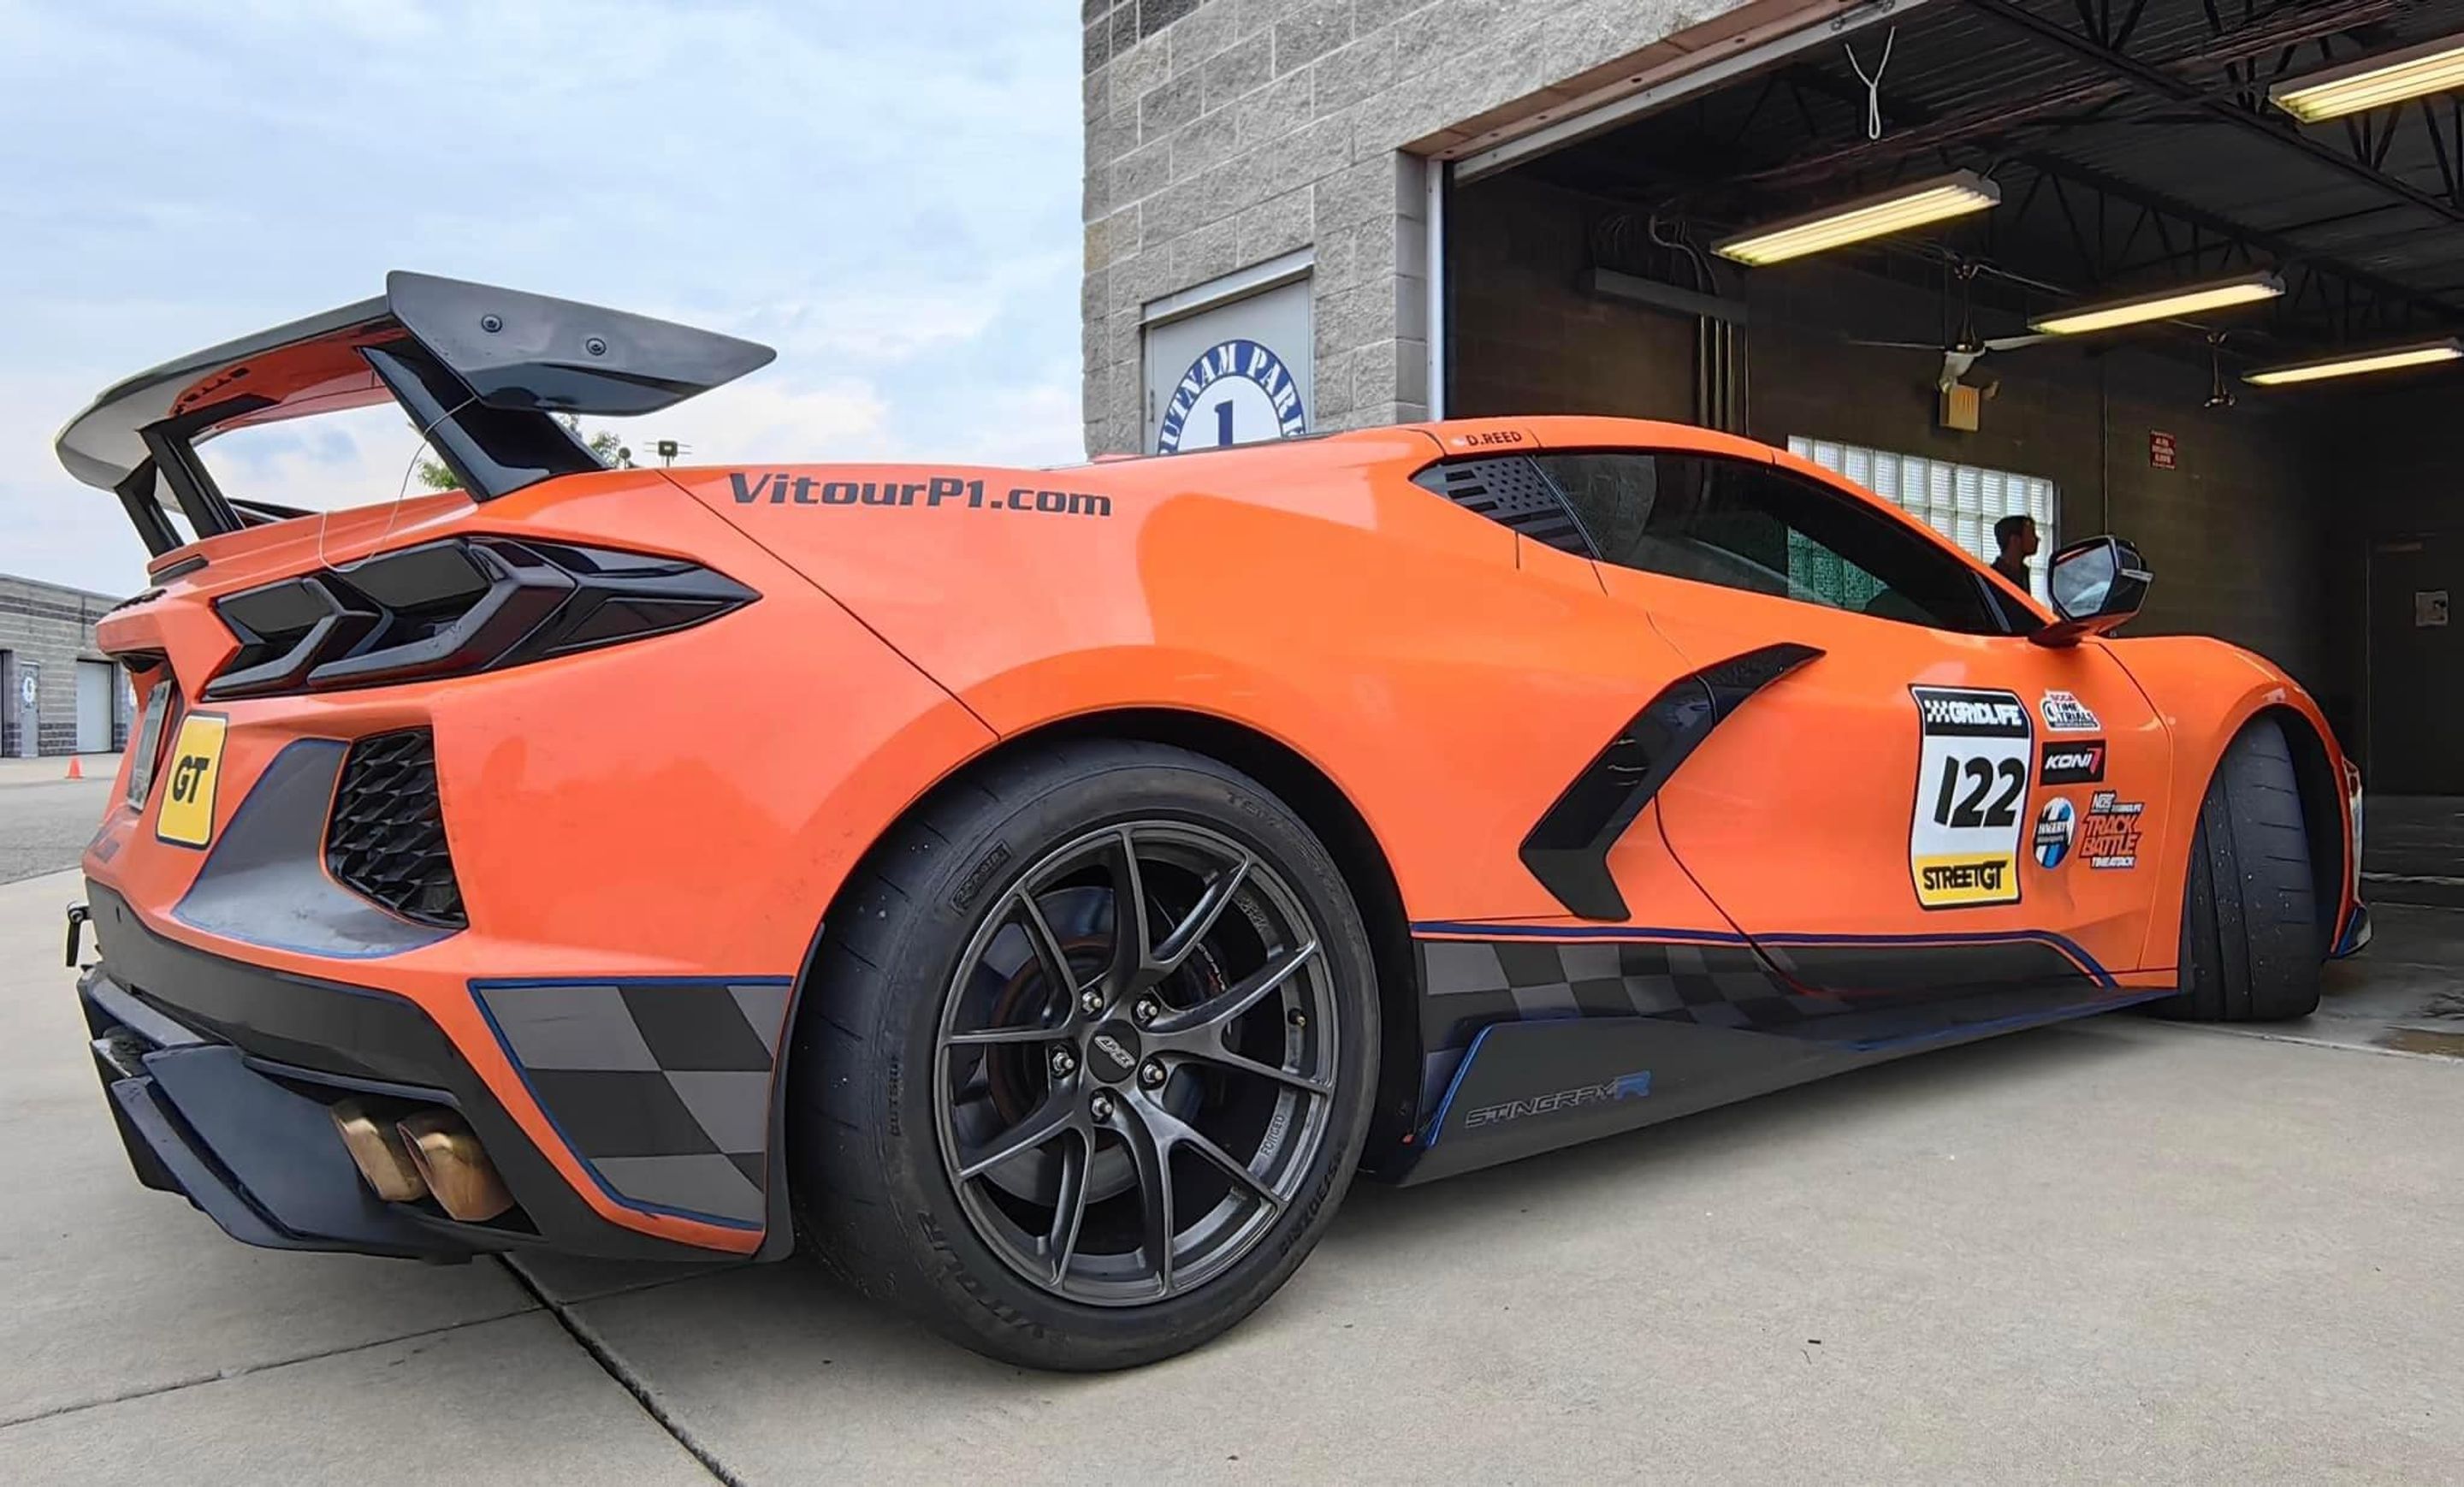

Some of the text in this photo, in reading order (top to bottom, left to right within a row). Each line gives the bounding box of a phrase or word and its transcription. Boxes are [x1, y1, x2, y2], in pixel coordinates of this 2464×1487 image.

[1159, 343, 1236, 454] UTNAM
[1215, 400, 1233, 447] 1
[1466, 431, 1522, 447] D.REED
[730, 472, 1111, 517] VitourP1.com
[1949, 702, 2022, 725] GRIDLIFE
[2044, 753, 2093, 770] KONI
[174, 756, 209, 803] GT
[1933, 755, 2026, 828] 122
[2086, 815, 2139, 838] TRACK
[2081, 834, 2139, 856] BATTLE
